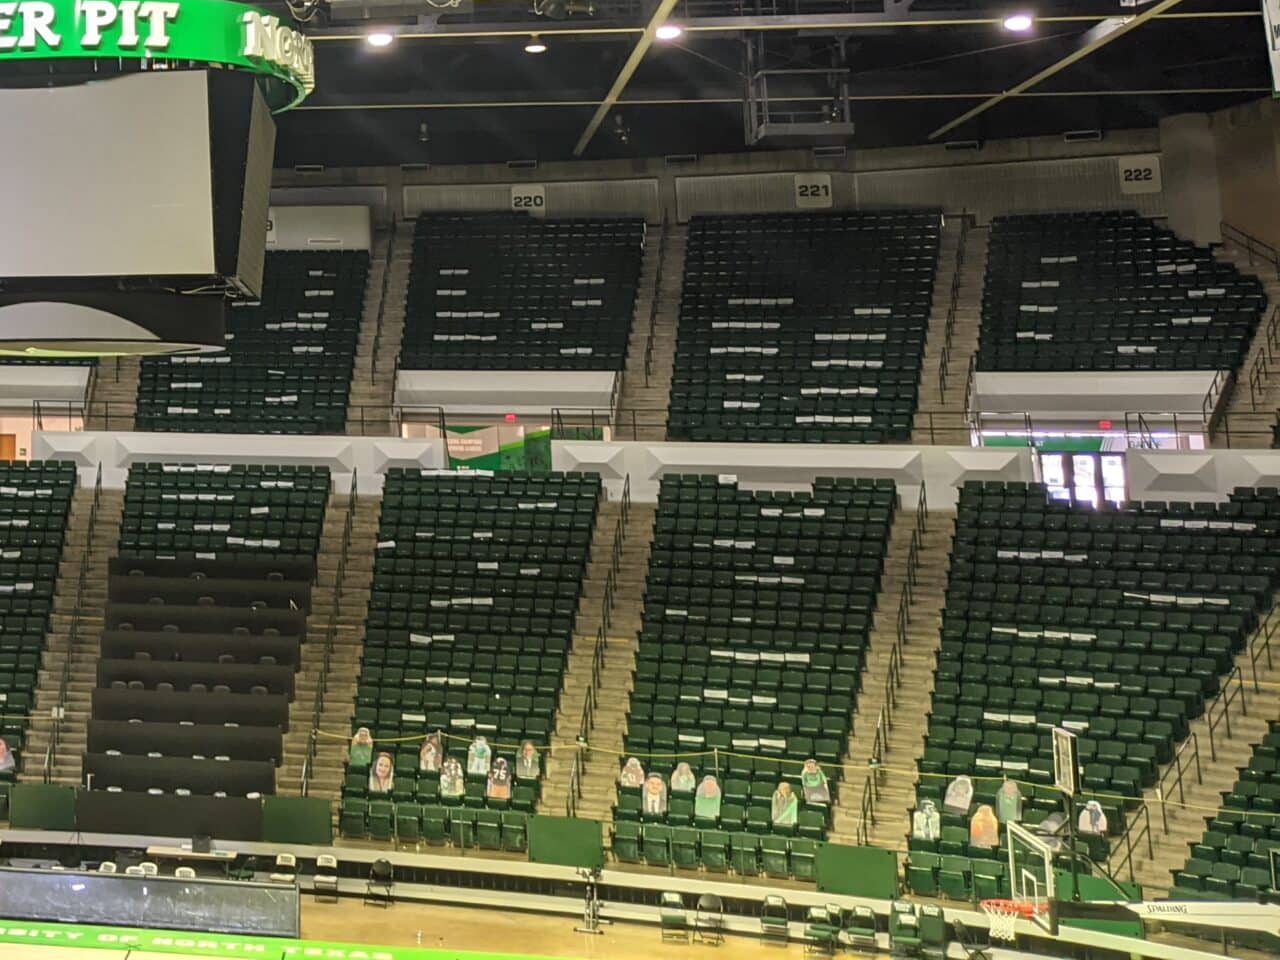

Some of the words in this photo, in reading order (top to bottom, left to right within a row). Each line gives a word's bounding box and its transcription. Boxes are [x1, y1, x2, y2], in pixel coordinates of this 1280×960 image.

[80, 0, 180, 49] PIT
[1123, 168, 1152, 181] 222
[798, 185, 829, 197] 221
[514, 195, 544, 207] 220
[493, 768, 507, 780] 75
[1146, 904, 1188, 913] SPALDING
[97, 933, 139, 945] OF
[151, 937, 266, 953] NORTH
[282, 945, 394, 960] TEXAS
